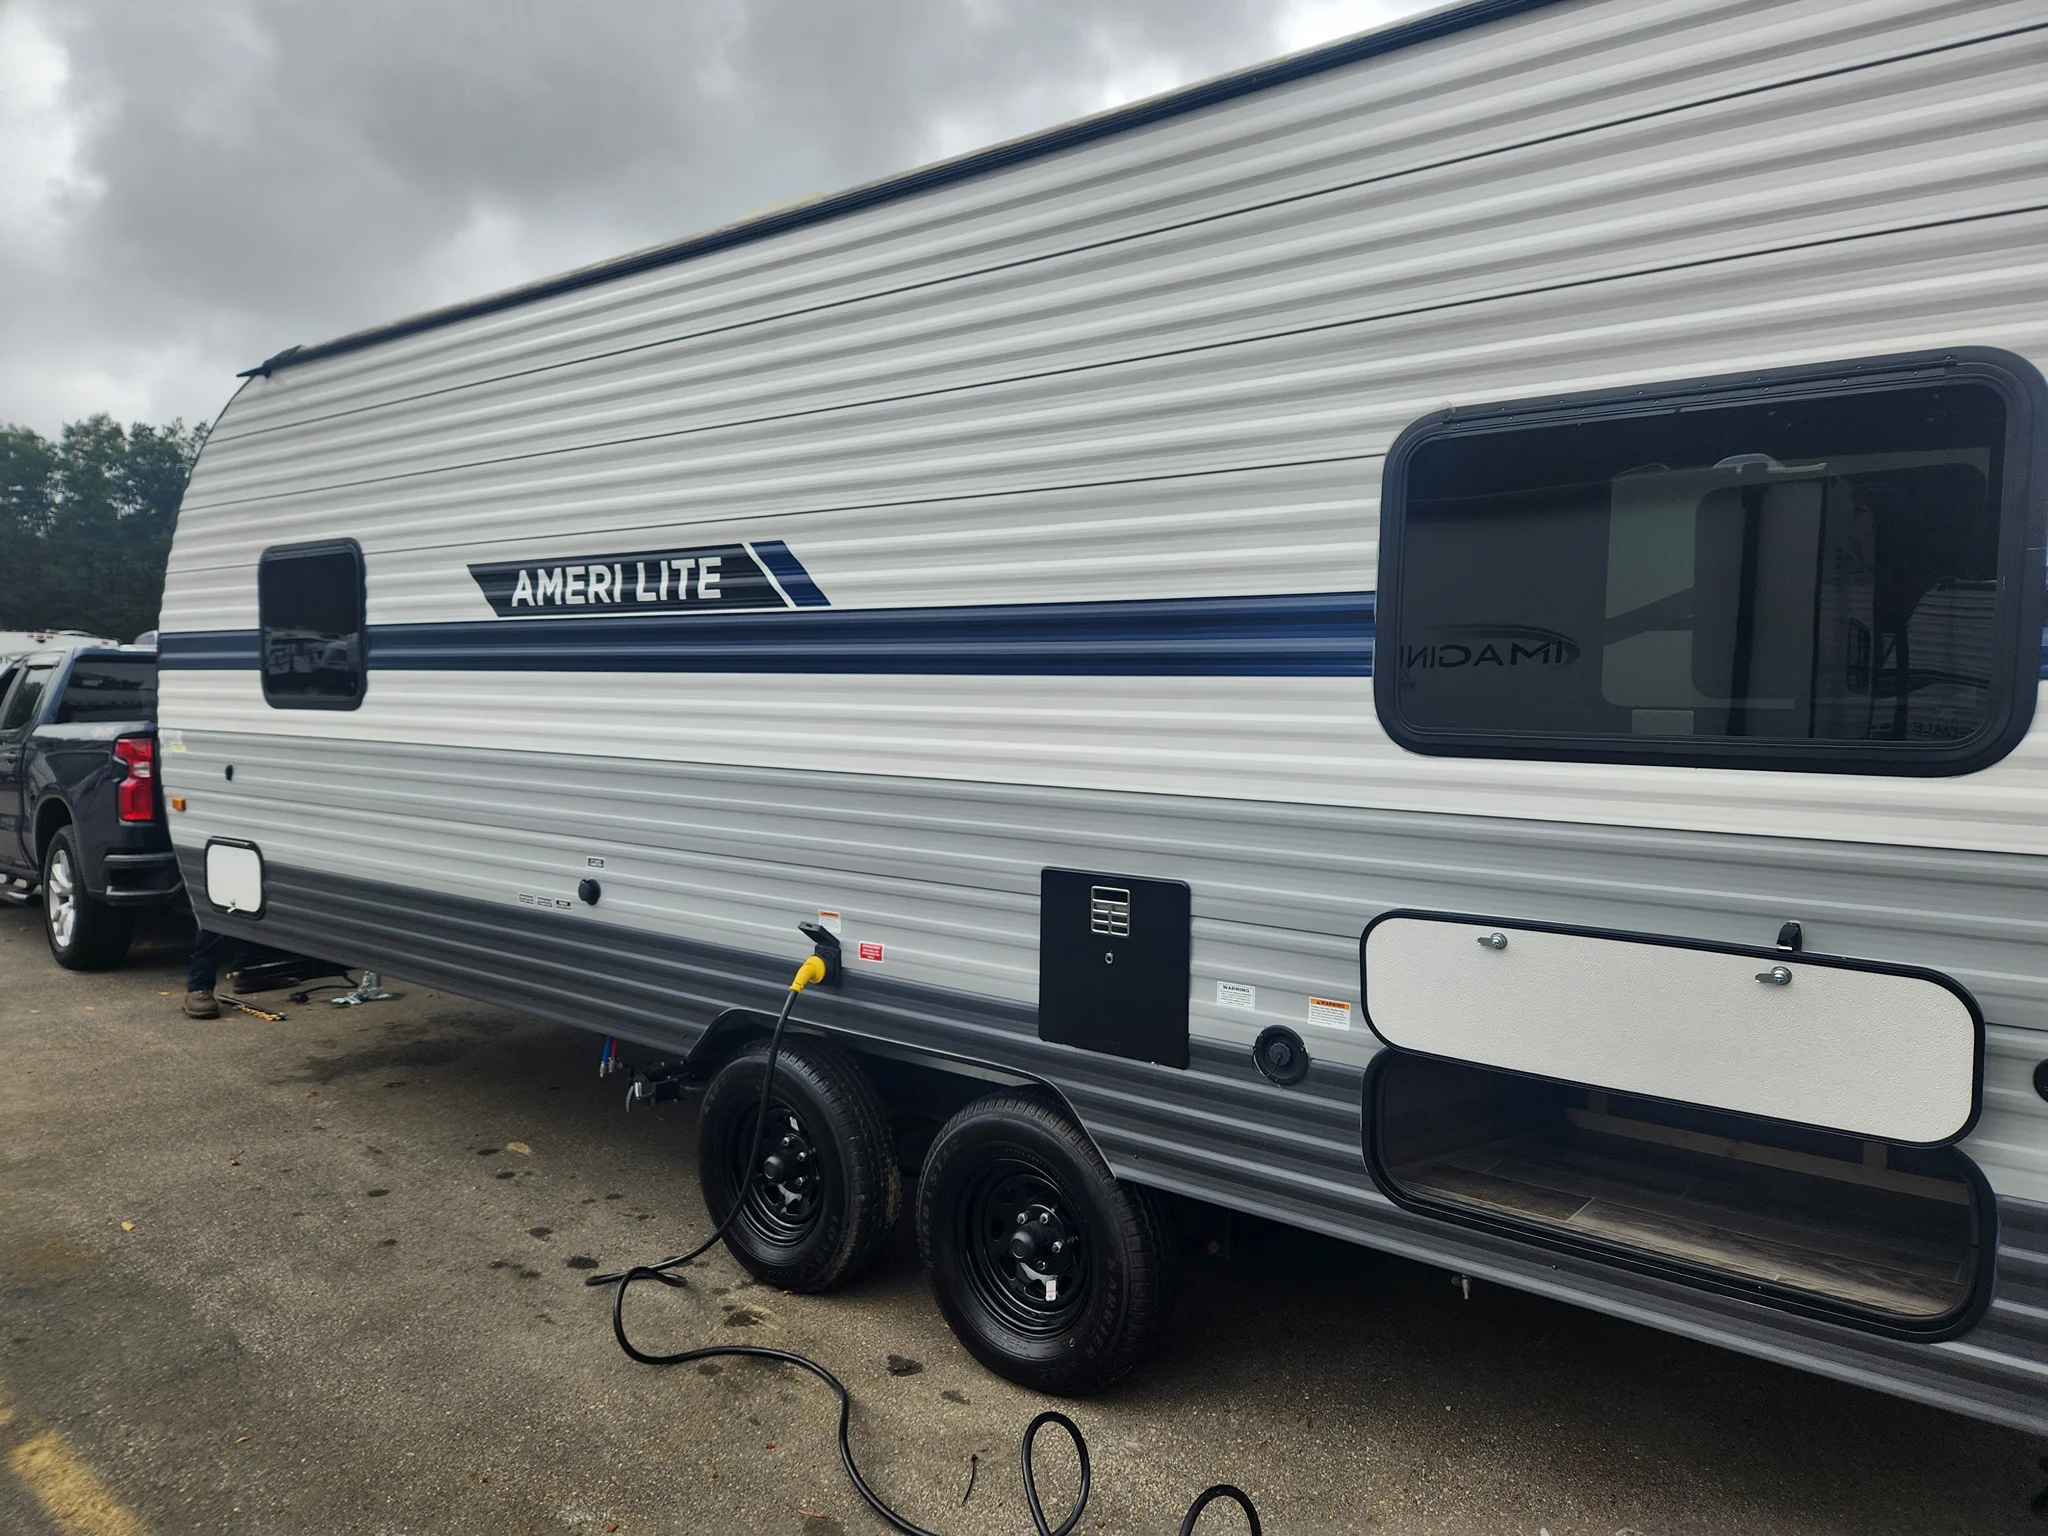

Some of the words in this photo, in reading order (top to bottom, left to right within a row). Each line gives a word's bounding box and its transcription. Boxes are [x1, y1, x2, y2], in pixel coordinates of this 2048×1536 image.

[511, 563, 623, 607] AMERI
[636, 556, 722, 602] LITE
[1222, 984, 1250, 993] WARNING
